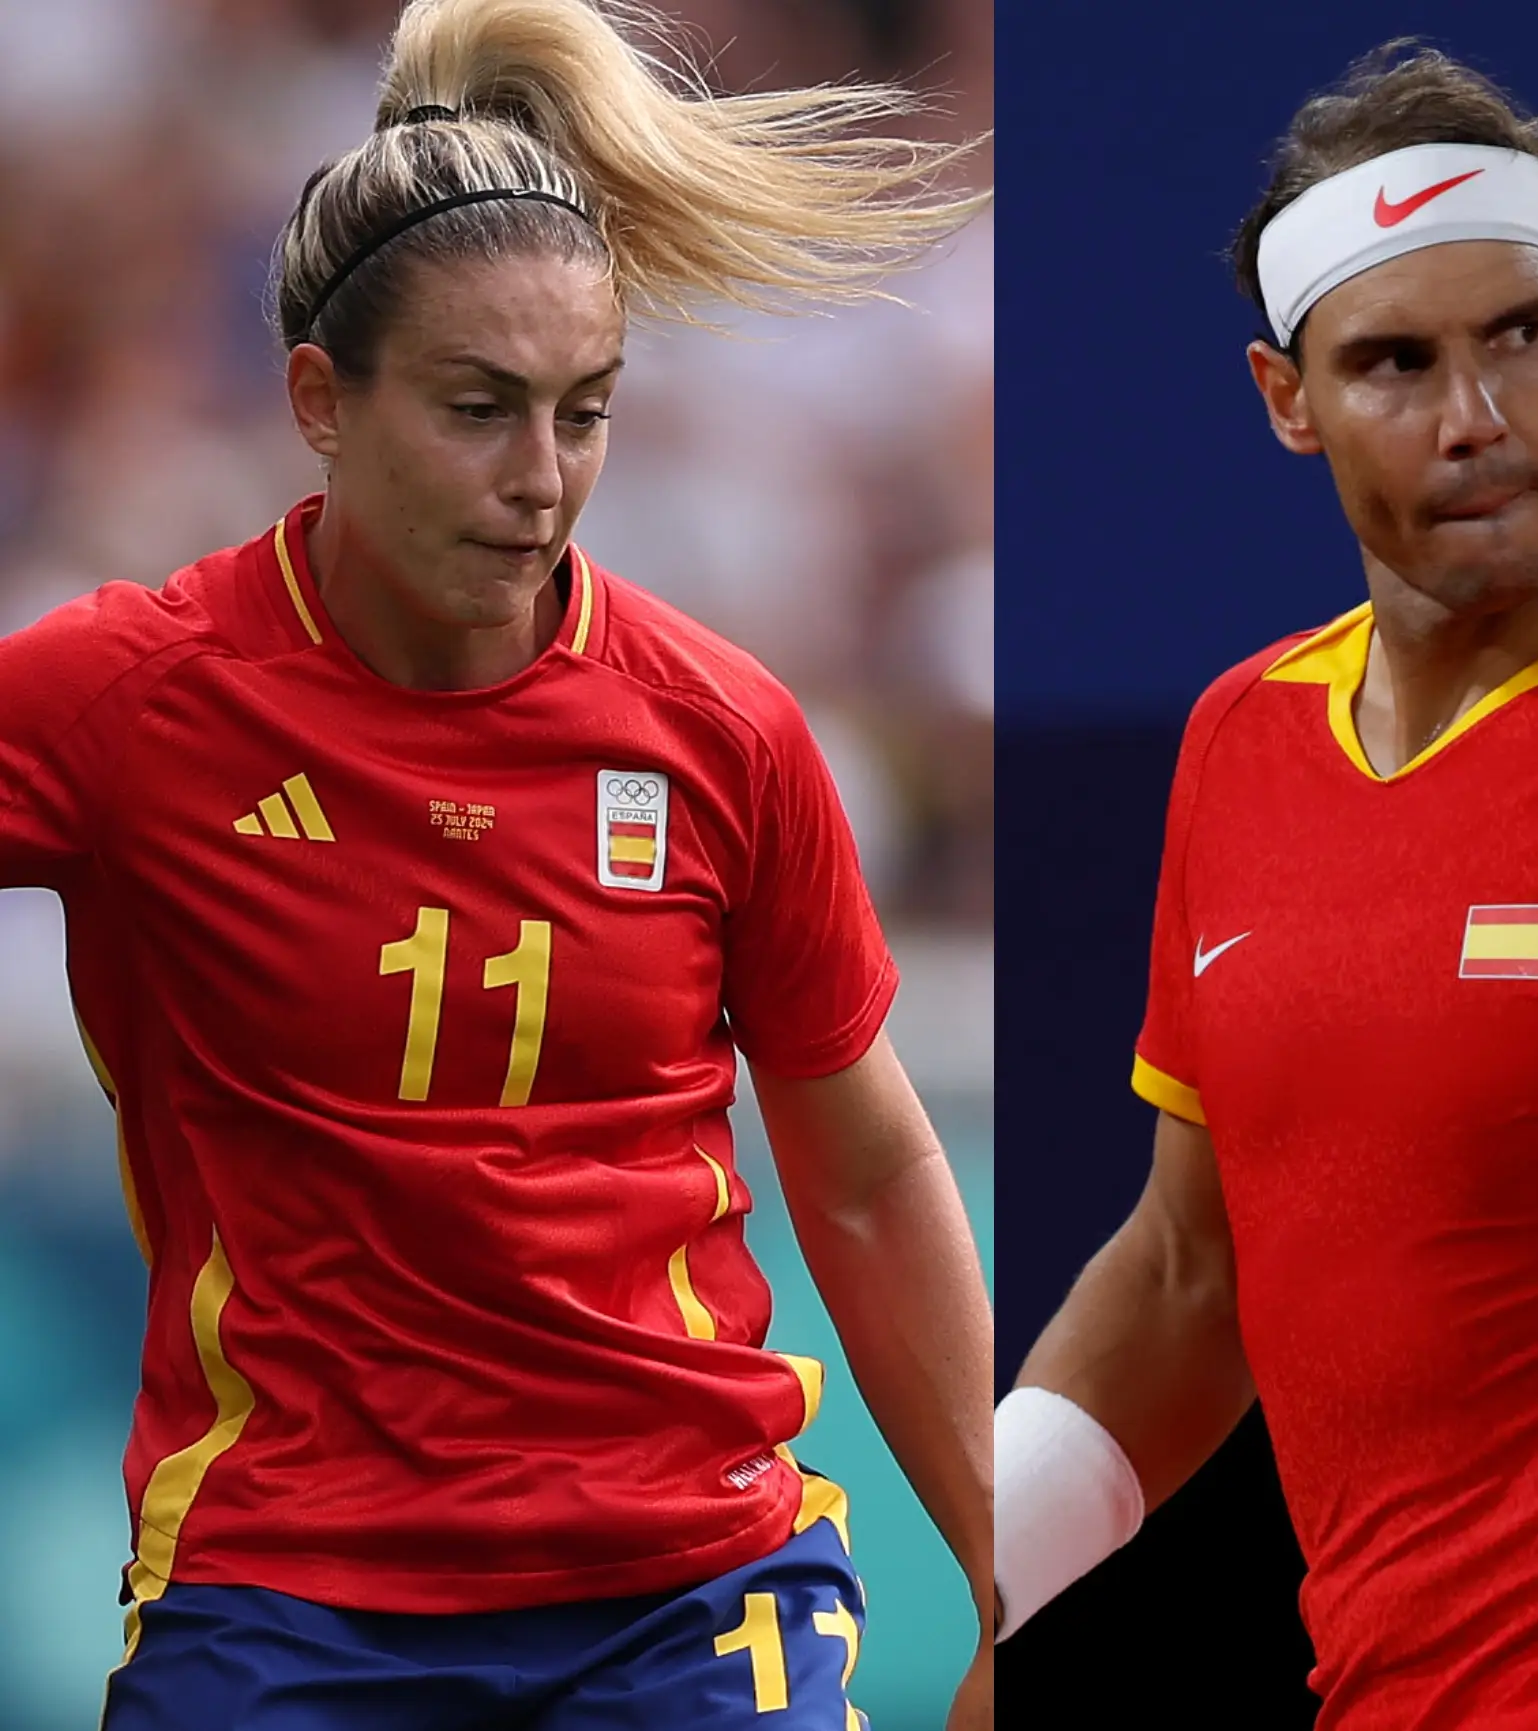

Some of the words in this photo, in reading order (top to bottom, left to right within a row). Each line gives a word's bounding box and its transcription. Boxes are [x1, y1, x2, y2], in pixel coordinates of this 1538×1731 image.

[429, 800, 457, 813] SPAIN
[466, 803, 496, 817] JAPAN
[612, 811, 653, 821] ESPAÑA
[430, 813, 443, 826] 25
[445, 814, 467, 827] JULY
[469, 816, 494, 829] 2024
[443, 827, 479, 841] NANTES
[380, 906, 551, 1107] 11
